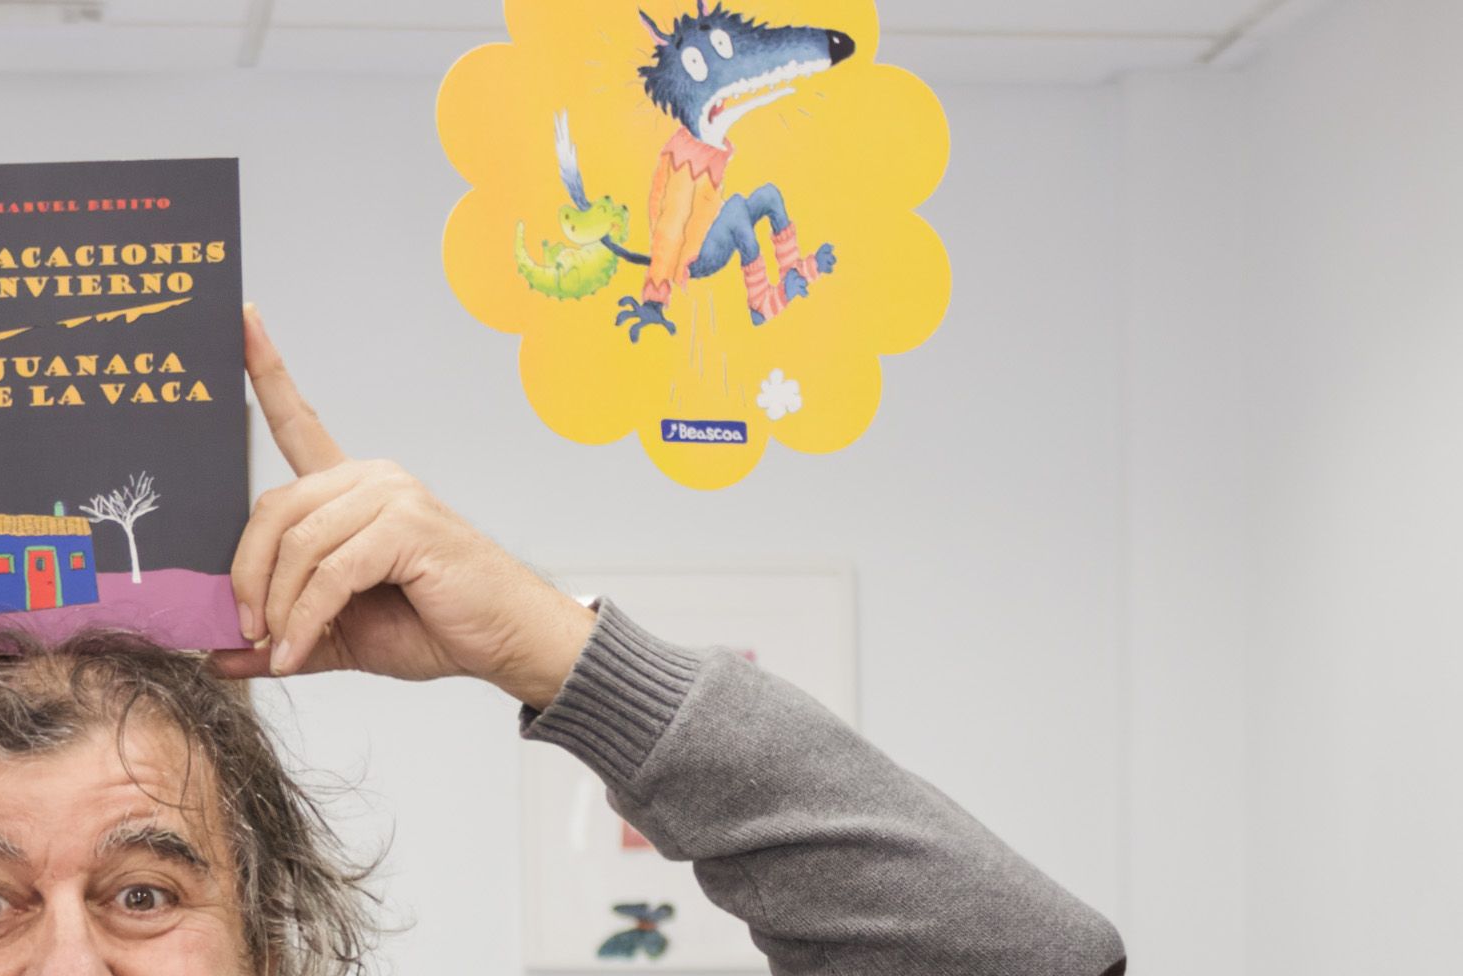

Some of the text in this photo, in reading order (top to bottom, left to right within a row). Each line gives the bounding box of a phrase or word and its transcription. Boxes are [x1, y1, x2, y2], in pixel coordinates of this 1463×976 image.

[88, 197, 171, 212] BENITO
[29, 385, 85, 407] LA
[100, 380, 213, 405] VACA
